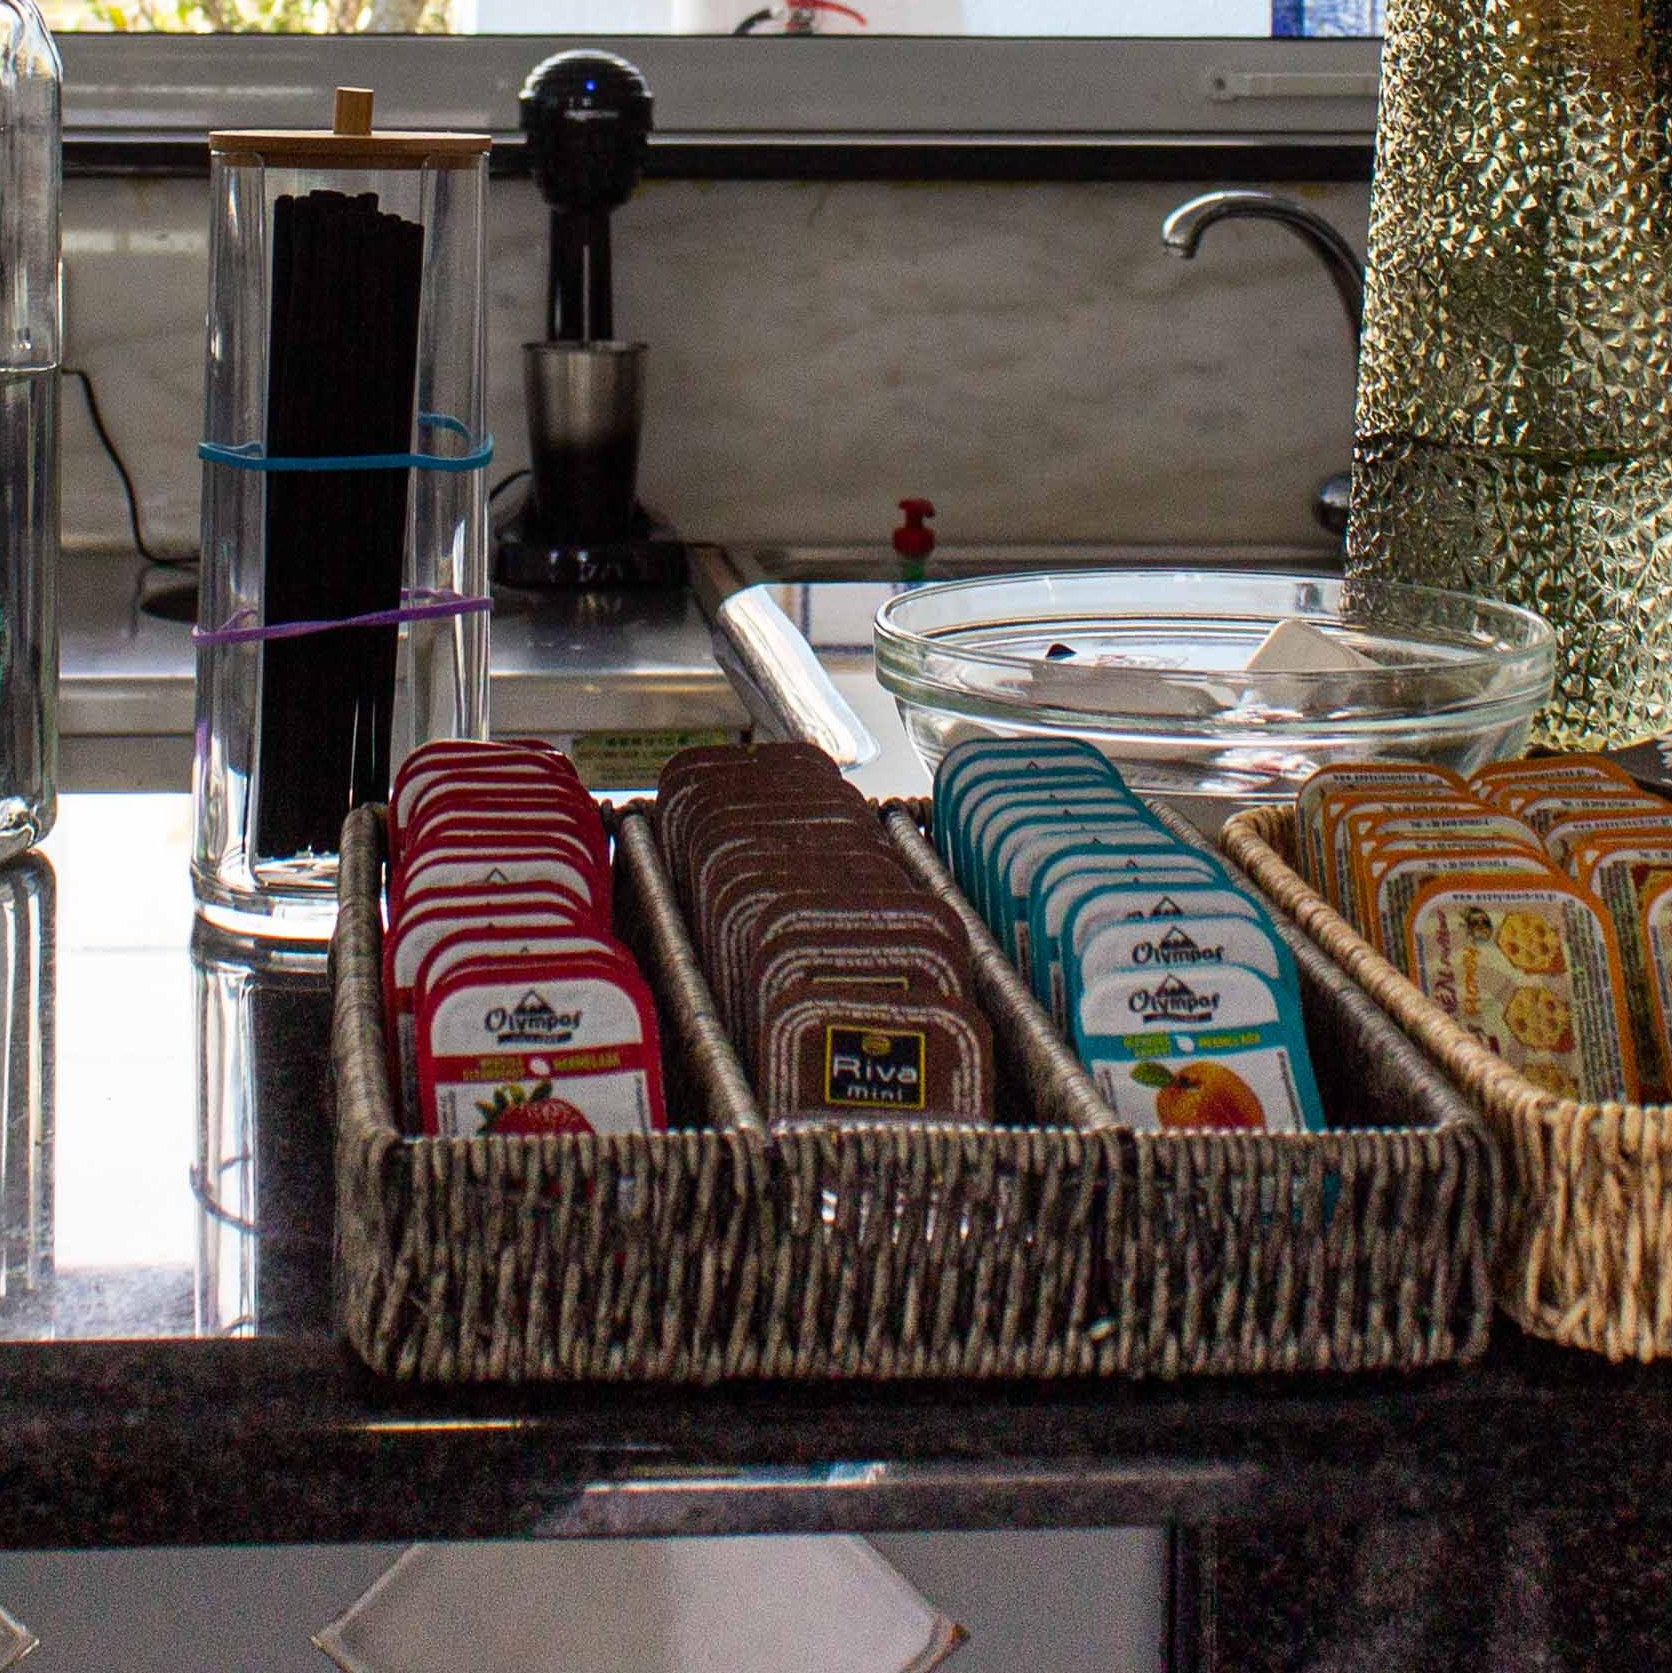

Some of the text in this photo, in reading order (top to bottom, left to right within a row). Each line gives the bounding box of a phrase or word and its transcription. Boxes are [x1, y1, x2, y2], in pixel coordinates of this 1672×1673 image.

[1132, 940, 1225, 965] Olympos
[1128, 986, 1221, 1015] Olympos
[484, 1006, 583, 1035] Olympos
[833, 1053, 919, 1083] Riva
[846, 1084, 904, 1102] mini
